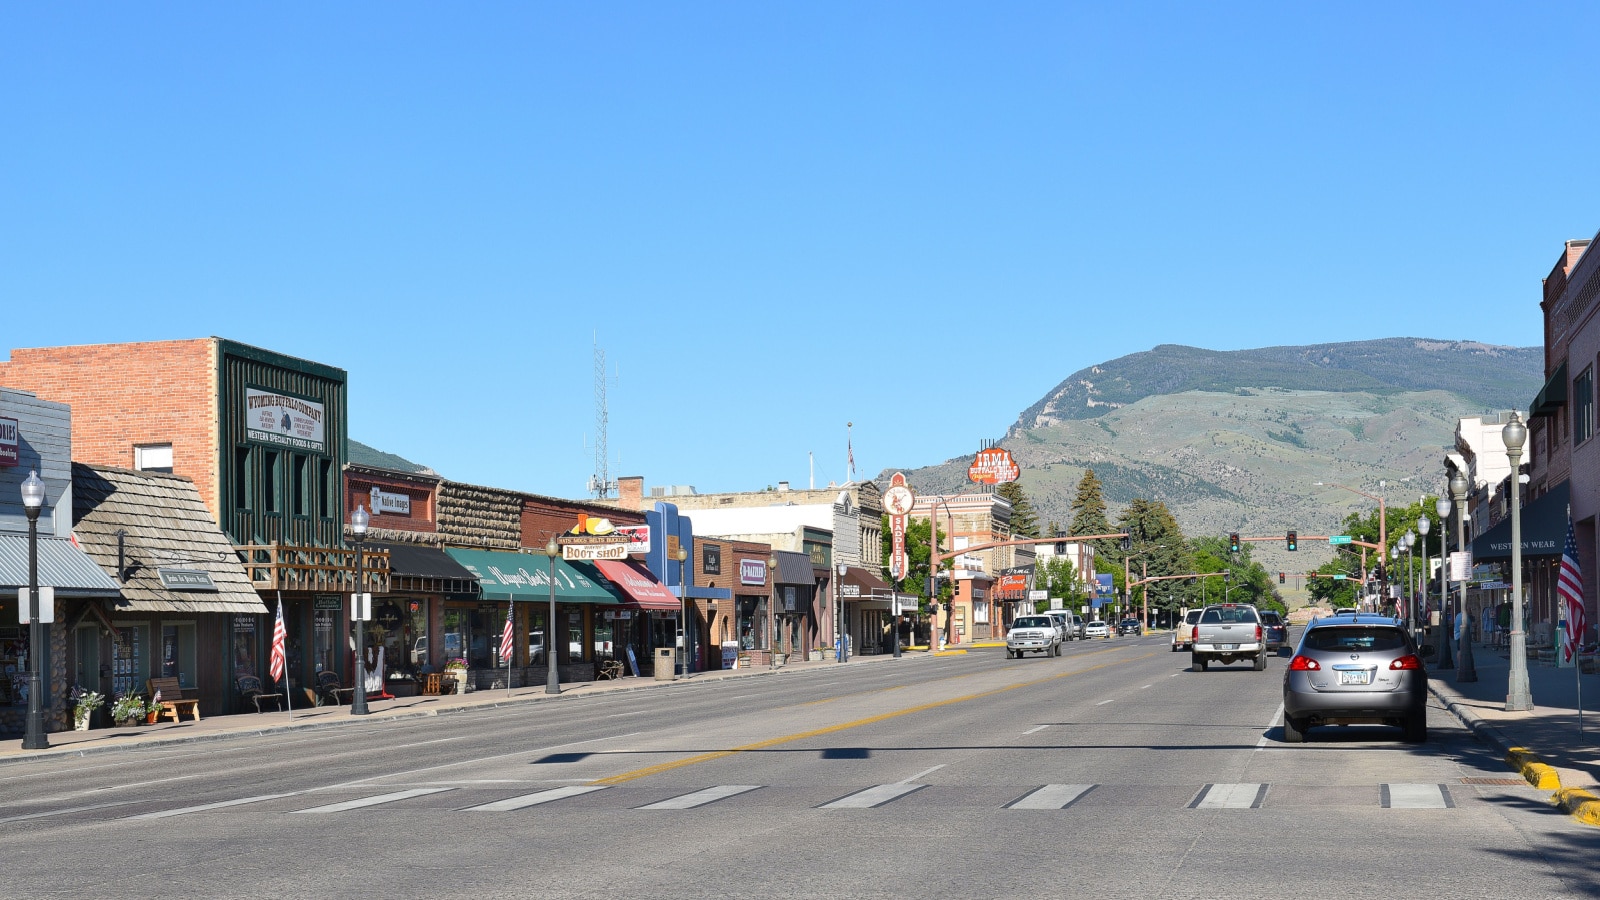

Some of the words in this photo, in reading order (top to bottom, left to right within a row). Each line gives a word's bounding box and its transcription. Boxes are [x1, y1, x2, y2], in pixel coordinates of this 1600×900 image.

[248, 395, 274, 410] WYOMING
[275, 395, 299, 411] BUFFALO
[299, 402, 322, 423] COMPANY
[248, 430, 269, 441] WESTERN
[269, 434, 292, 446] SPECIALTY
[292, 439, 307, 448] FOODS
[311, 443, 323, 451] GIFTS
[978, 452, 1010, 467] IRMA
[894, 517, 903, 570] SADDLERY
[1490, 542, 1529, 550] WESTRN
[566, 546, 593, 558] BOOT
[597, 546, 625, 558] SHOP
[1006, 568, 1030, 576] Irma
